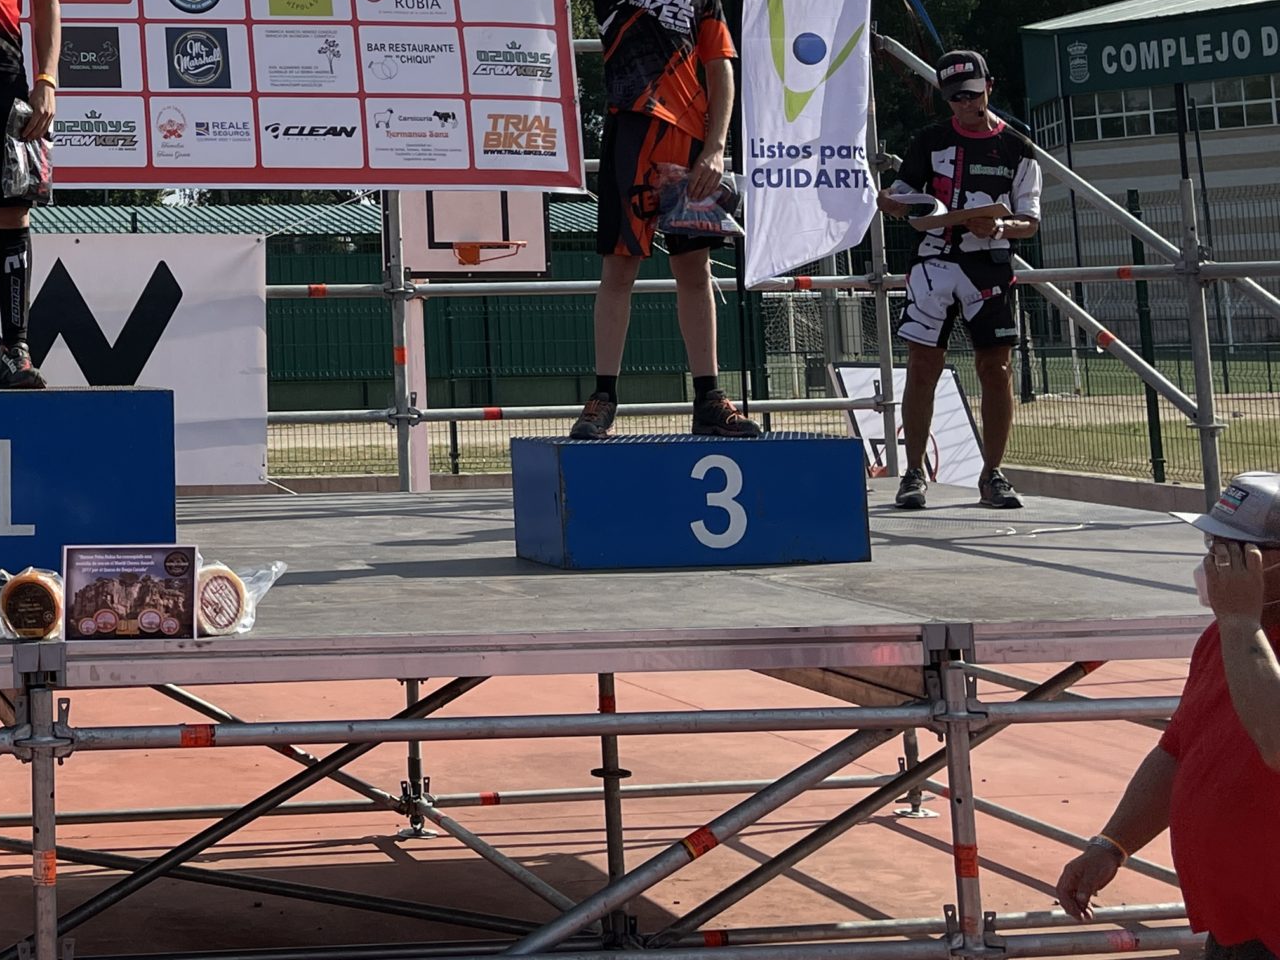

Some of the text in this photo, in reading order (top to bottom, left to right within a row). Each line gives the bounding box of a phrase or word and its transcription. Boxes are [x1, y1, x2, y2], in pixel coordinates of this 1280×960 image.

[80, 52, 97, 62] DR
[366, 43, 455, 53] BAR RESTAURANTE
[1101, 29, 1251, 75] COMPLEJO
[174, 48, 221, 73] Marshall
[395, 54, 435, 64] "CHIQUI"
[212, 121, 250, 130] REALE
[282, 126, 358, 138] CLEAN
[487, 113, 557, 134] TRIAL
[483, 131, 557, 150] BIKES
[751, 138, 812, 160] Listos
[690, 454, 748, 549] 3
